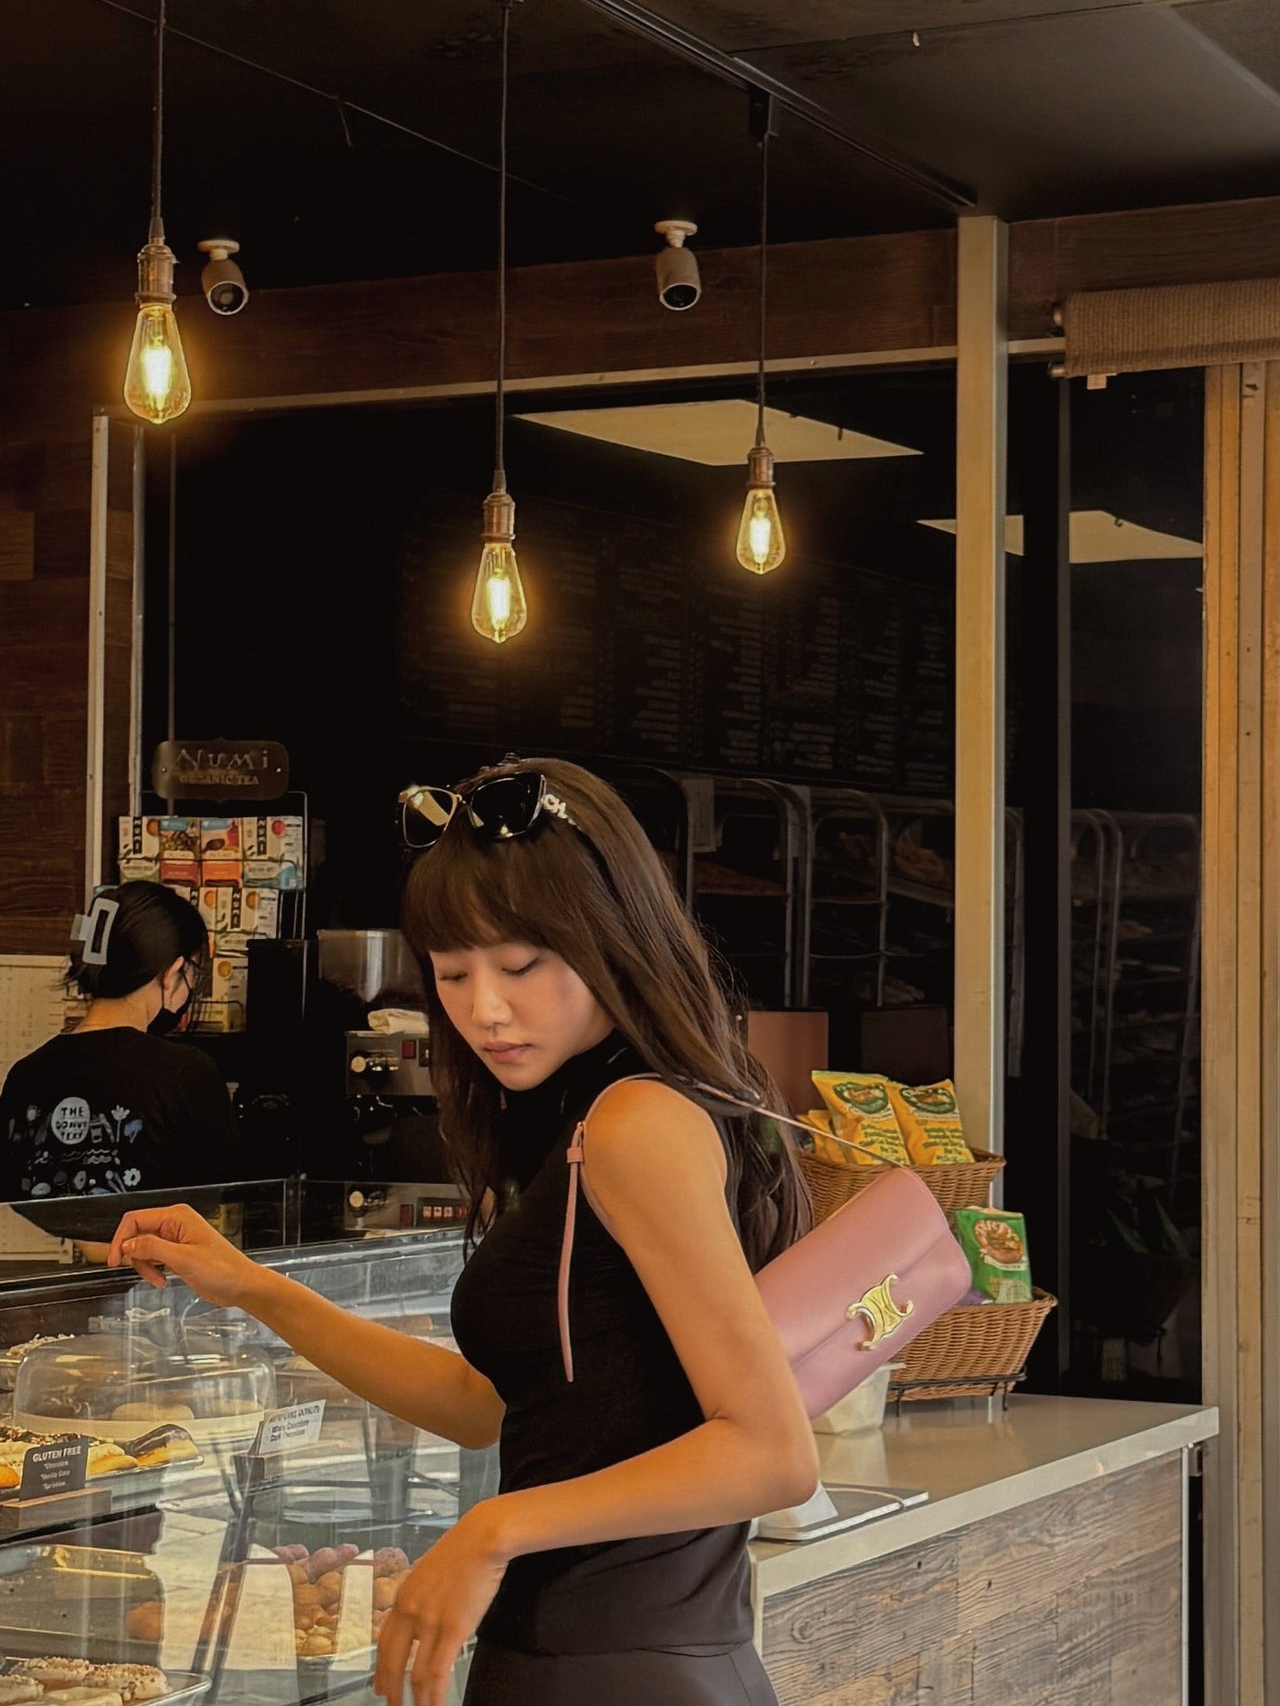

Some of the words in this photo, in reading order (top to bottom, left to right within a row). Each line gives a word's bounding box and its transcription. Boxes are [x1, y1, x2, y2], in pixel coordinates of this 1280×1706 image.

[180, 774, 233, 785] ORGANIC
[239, 775, 259, 785] TEA
[61, 1106, 84, 1117] THE
[33, 1449, 62, 1463] GLUTEN
[63, 1446, 81, 1457] FREE
